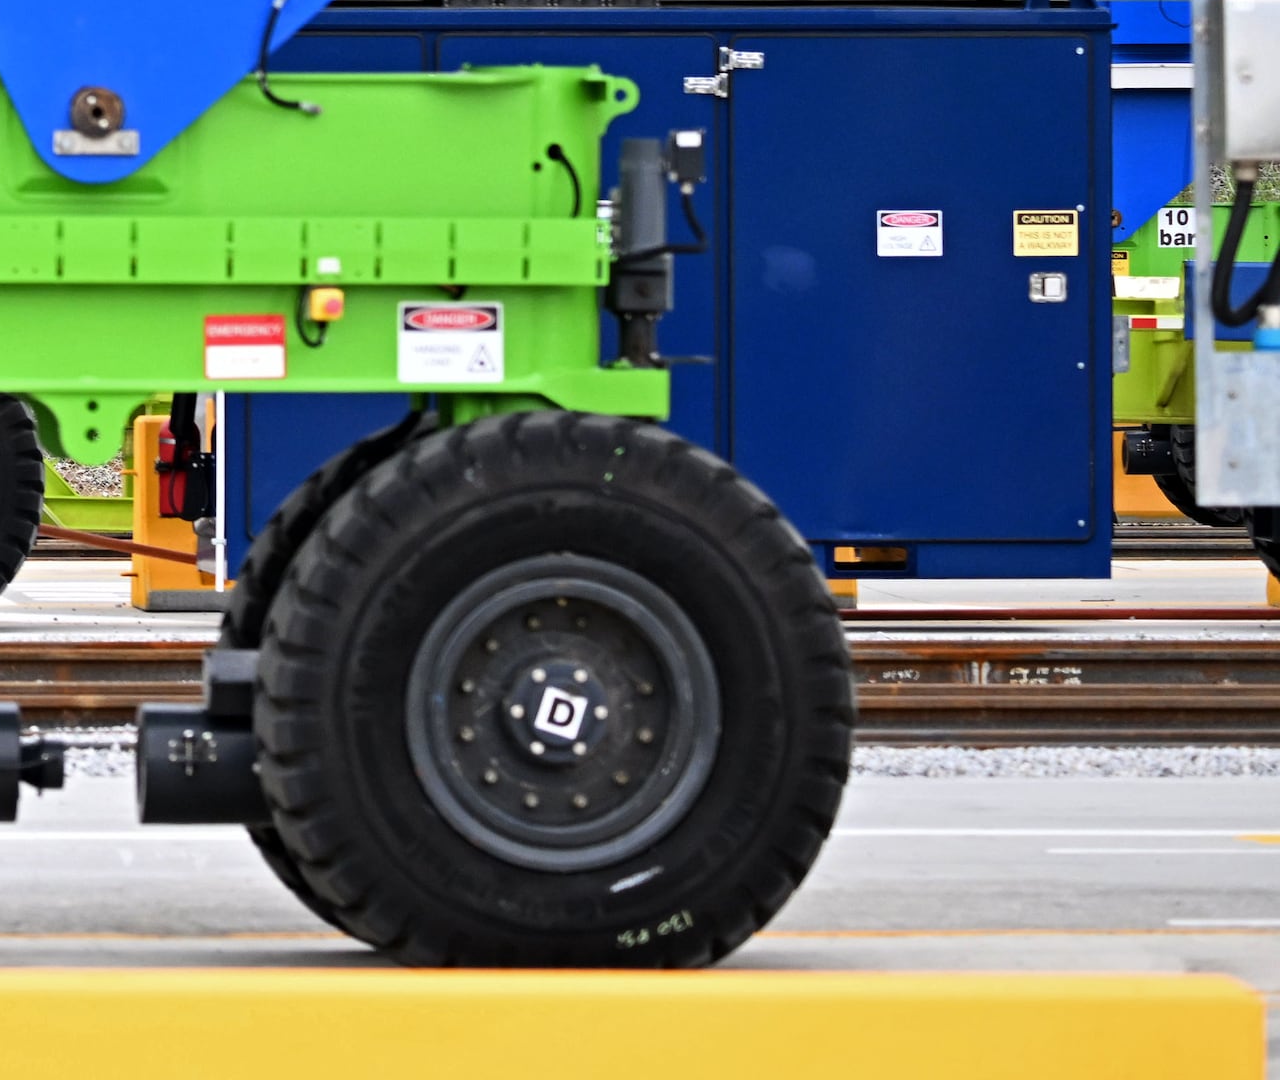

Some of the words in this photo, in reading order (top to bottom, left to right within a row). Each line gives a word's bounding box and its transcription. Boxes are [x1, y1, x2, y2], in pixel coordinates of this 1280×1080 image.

[890, 215, 928, 224] DANGER
[1021, 215, 1070, 223] CAUTION
[1165, 209, 1189, 226] 10
[547, 696, 575, 727] D
